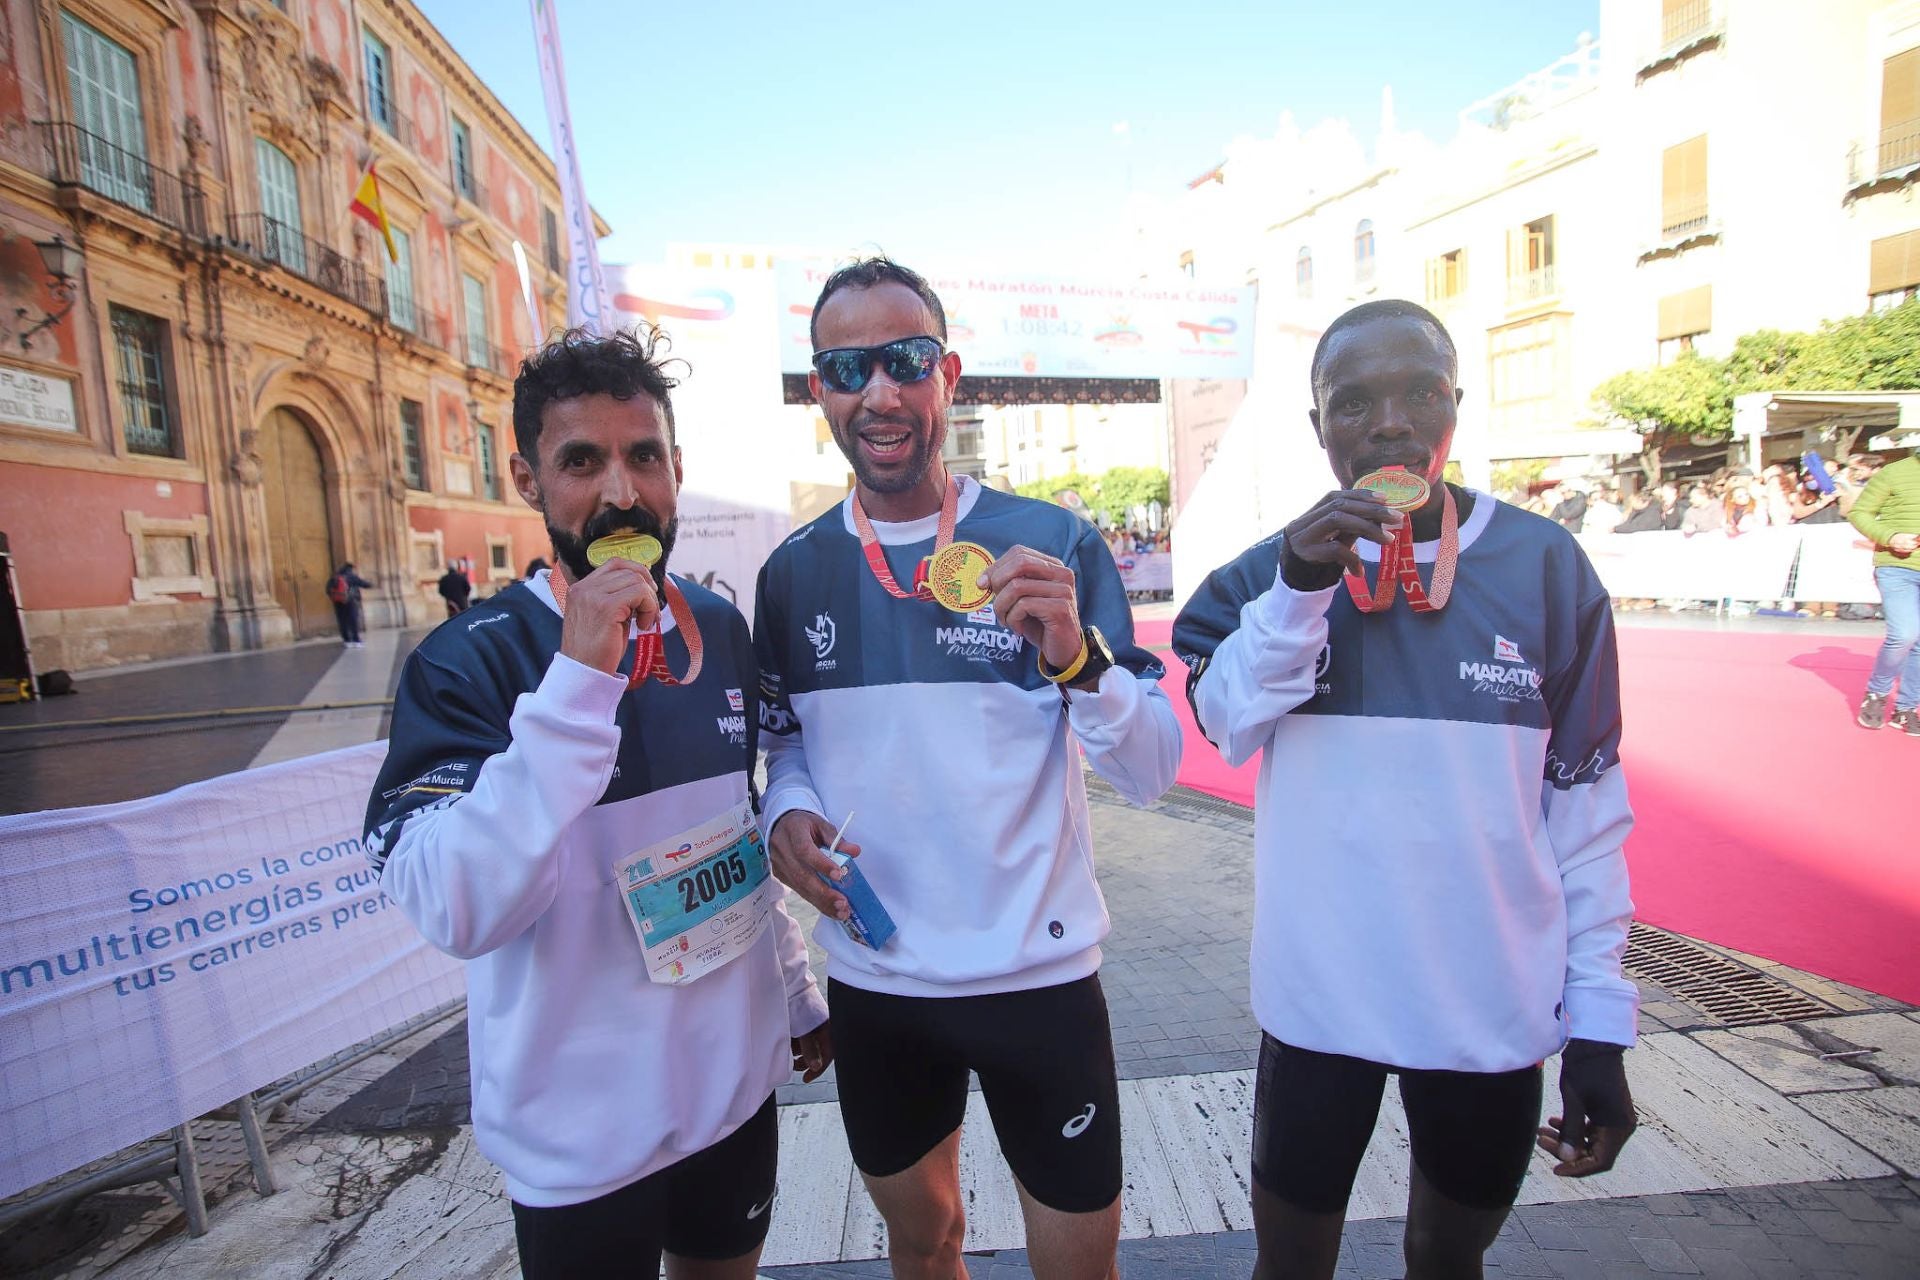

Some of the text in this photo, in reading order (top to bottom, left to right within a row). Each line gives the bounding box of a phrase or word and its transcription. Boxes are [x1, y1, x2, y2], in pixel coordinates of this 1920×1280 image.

[967, 278, 1053, 295] Maratón
[1060, 284, 1124, 299] Murcia
[1020, 304, 1059, 319] META
[1002, 319, 1083, 337] 1:08:42
[696, 528, 736, 539] Murcia
[936, 627, 1024, 654] MARATÓN
[431, 774, 465, 786] Murcia
[128, 867, 254, 913] Somos
[261, 856, 290, 878] la
[677, 851, 747, 914] 2005
[1, 869, 377, 995] multienergías qu
[112, 961, 177, 997] tus
[188, 915, 323, 973] carreras
